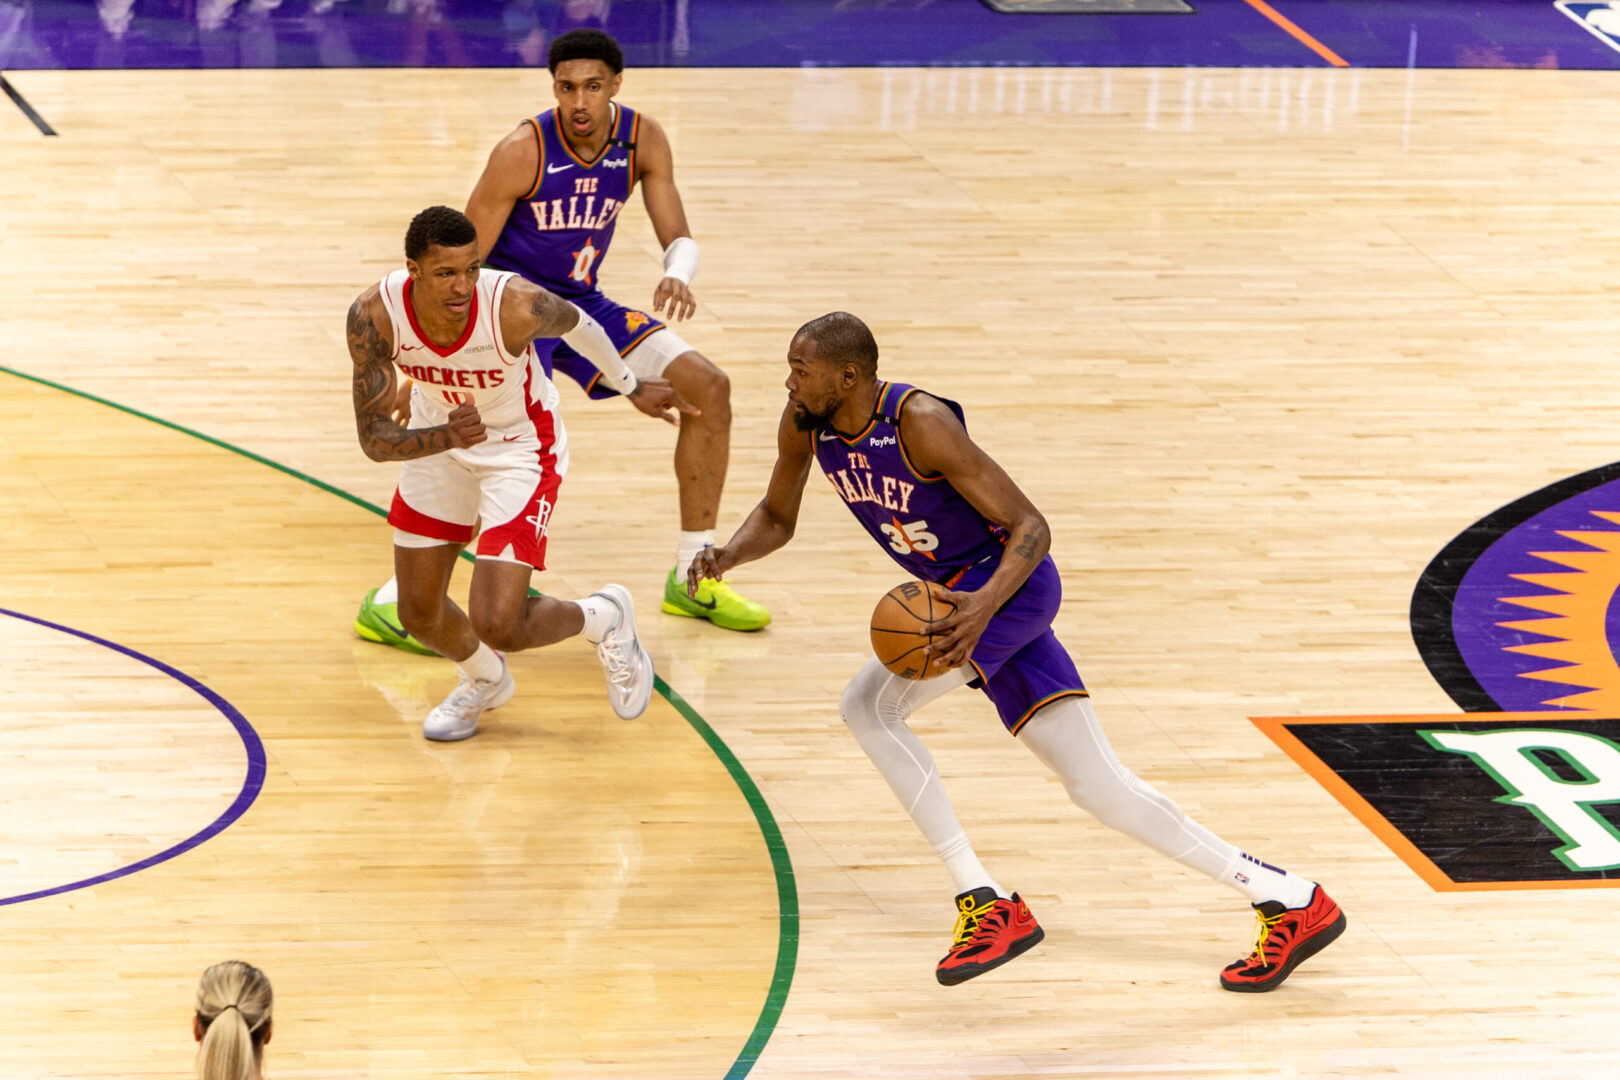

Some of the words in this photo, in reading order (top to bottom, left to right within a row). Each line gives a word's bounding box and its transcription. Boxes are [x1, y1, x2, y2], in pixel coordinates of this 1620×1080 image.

[602, 158, 628, 169] PayPal
[574, 177, 599, 194] THE
[573, 245, 595, 281] 0
[869, 435, 896, 448] PayPal
[880, 520, 939, 555] 35
